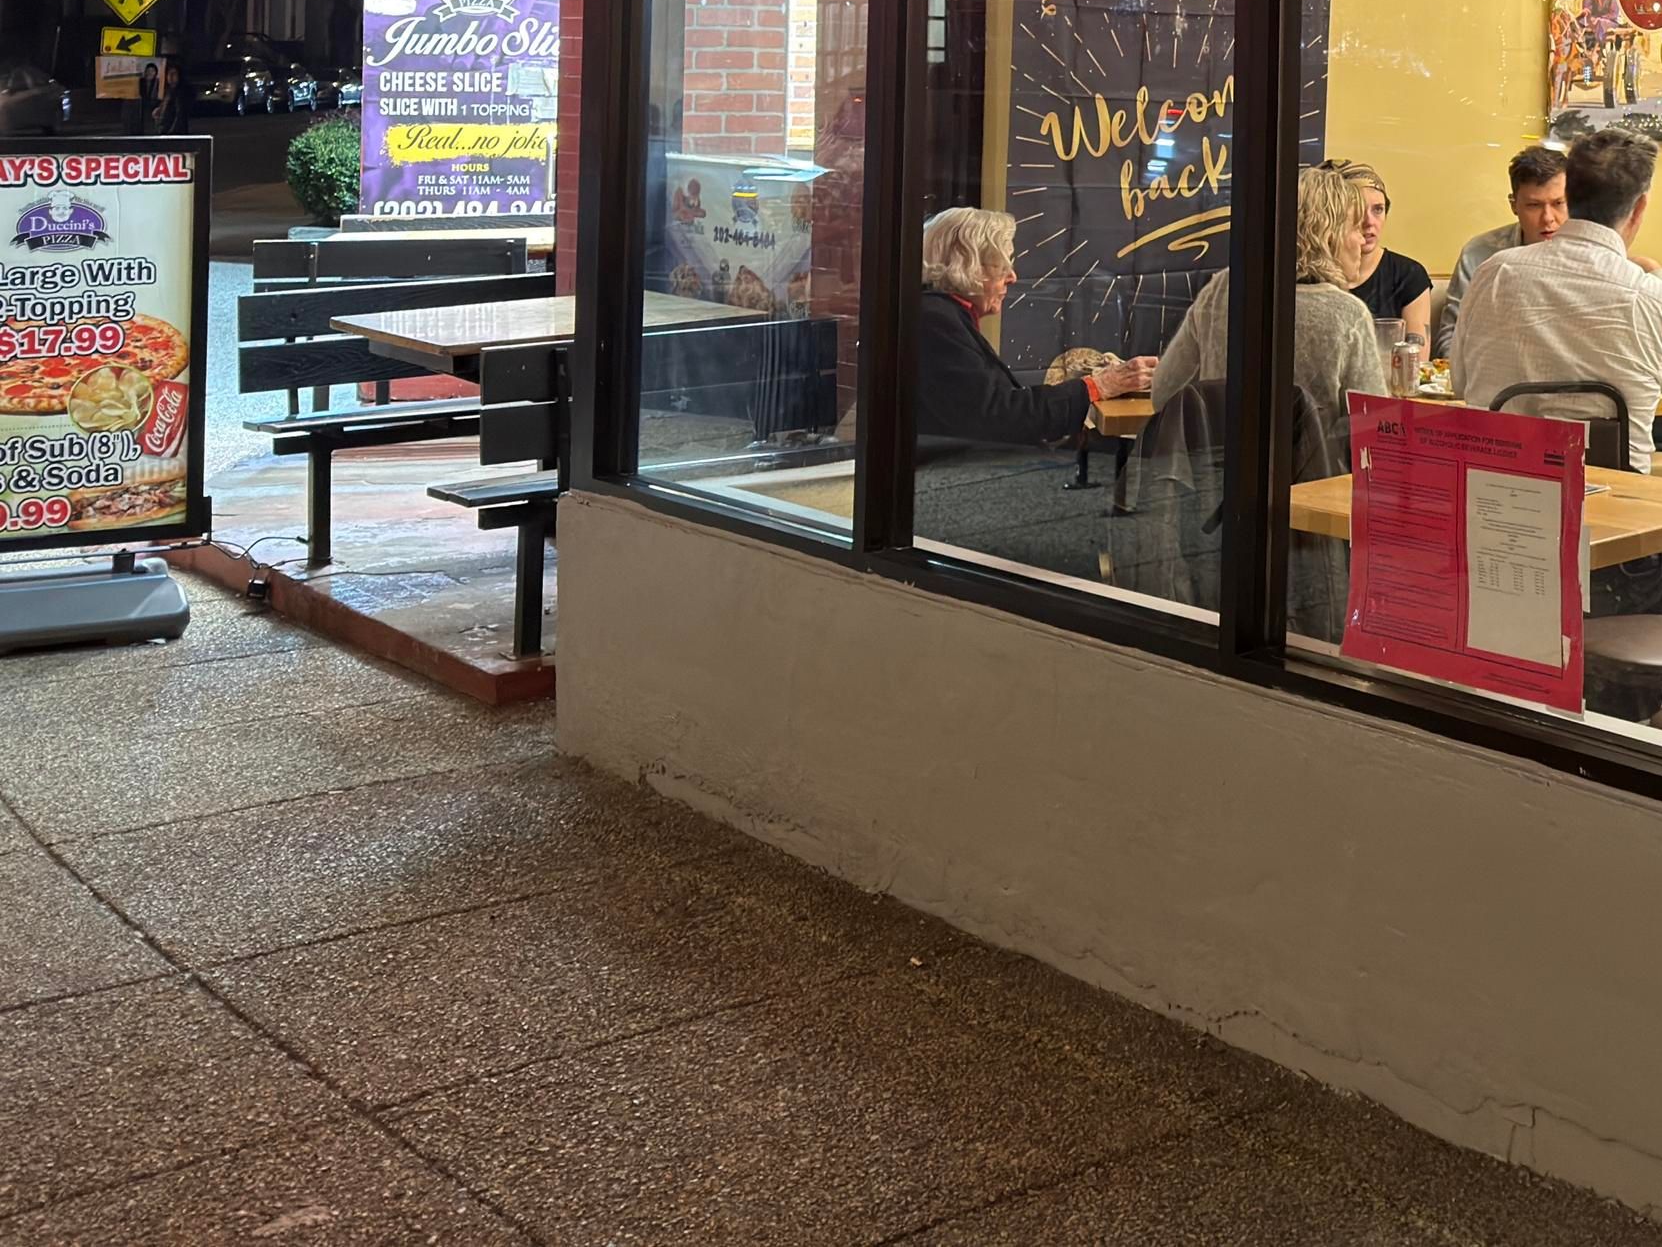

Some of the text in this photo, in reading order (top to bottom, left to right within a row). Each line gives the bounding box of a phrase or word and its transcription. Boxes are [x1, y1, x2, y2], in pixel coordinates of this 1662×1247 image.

[366, 16, 499, 66] Jumbo
[379, 71, 503, 92] CHEESE SLICE
[379, 97, 530, 116] SLICE WITH 1 TOPPING
[64, 155, 189, 181] SPECIAL
[451, 163, 490, 172] HOURS
[1119, 136, 1233, 220] back
[418, 175, 438, 184] FRI
[438, 175, 449, 184] &
[450, 175, 469, 184] SAT
[506, 175, 530, 184] 5AM
[418, 186, 456, 195] THURS
[462, 186, 490, 195] 11AM
[506, 186, 530, 195] 4AM
[30, 216, 95, 233] Duccini's
[42, 234, 81, 246] PIZZA
[86, 258, 152, 283] With
[0, 292, 135, 322] -Topping
[0, 325, 122, 359] $17.99
[13, 468, 37, 490] &
[43, 464, 119, 486] Soda
